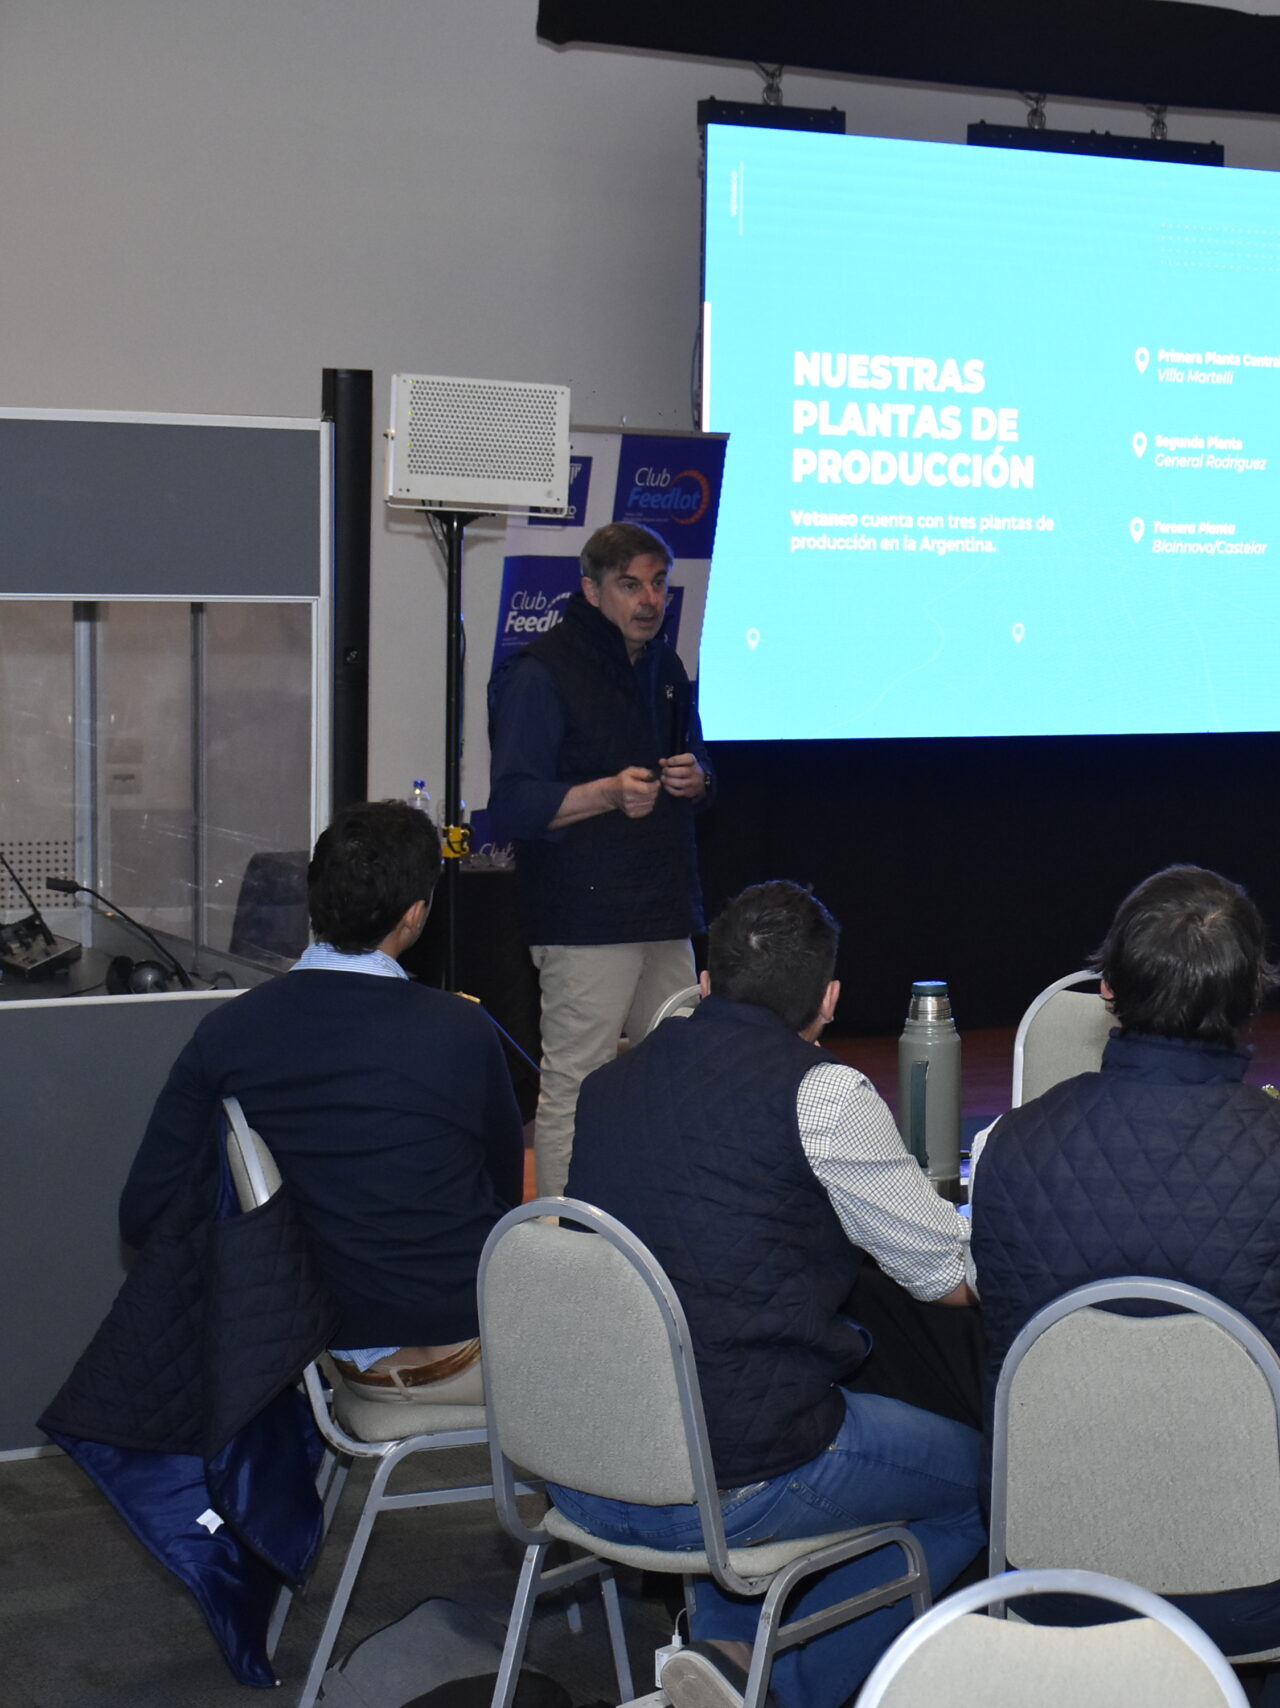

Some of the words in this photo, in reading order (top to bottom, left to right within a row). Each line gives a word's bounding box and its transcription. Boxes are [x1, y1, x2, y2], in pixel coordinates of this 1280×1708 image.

[1158, 348, 1203, 364] Primera
[1205, 351, 1241, 366] Planta
[794, 351, 986, 393] NUESTRAS
[1158, 368, 1184, 383] Villa
[1187, 370, 1234, 385] Martelli
[793, 400, 962, 440] PLANTAS
[971, 407, 1019, 442] DE
[1155, 434, 1205, 451] Segunda
[1207, 435, 1243, 450] Planta
[793, 445, 1034, 488] PRODUCCIÓN
[1155, 453, 1204, 468] General
[635, 467, 671, 487] Club
[627, 486, 700, 510] Feedlot
[790, 509, 858, 527] Vetanco
[861, 513, 914, 529] cuenta
[917, 515, 945, 529] con
[948, 513, 977, 529] tres
[979, 513, 1034, 534] plantas
[1035, 514, 1055, 531] de
[791, 532, 877, 552] producción
[880, 538, 900, 551] en
[903, 535, 917, 551] la
[919, 535, 997, 555] Argentina.
[512, 590, 547, 610] Club
